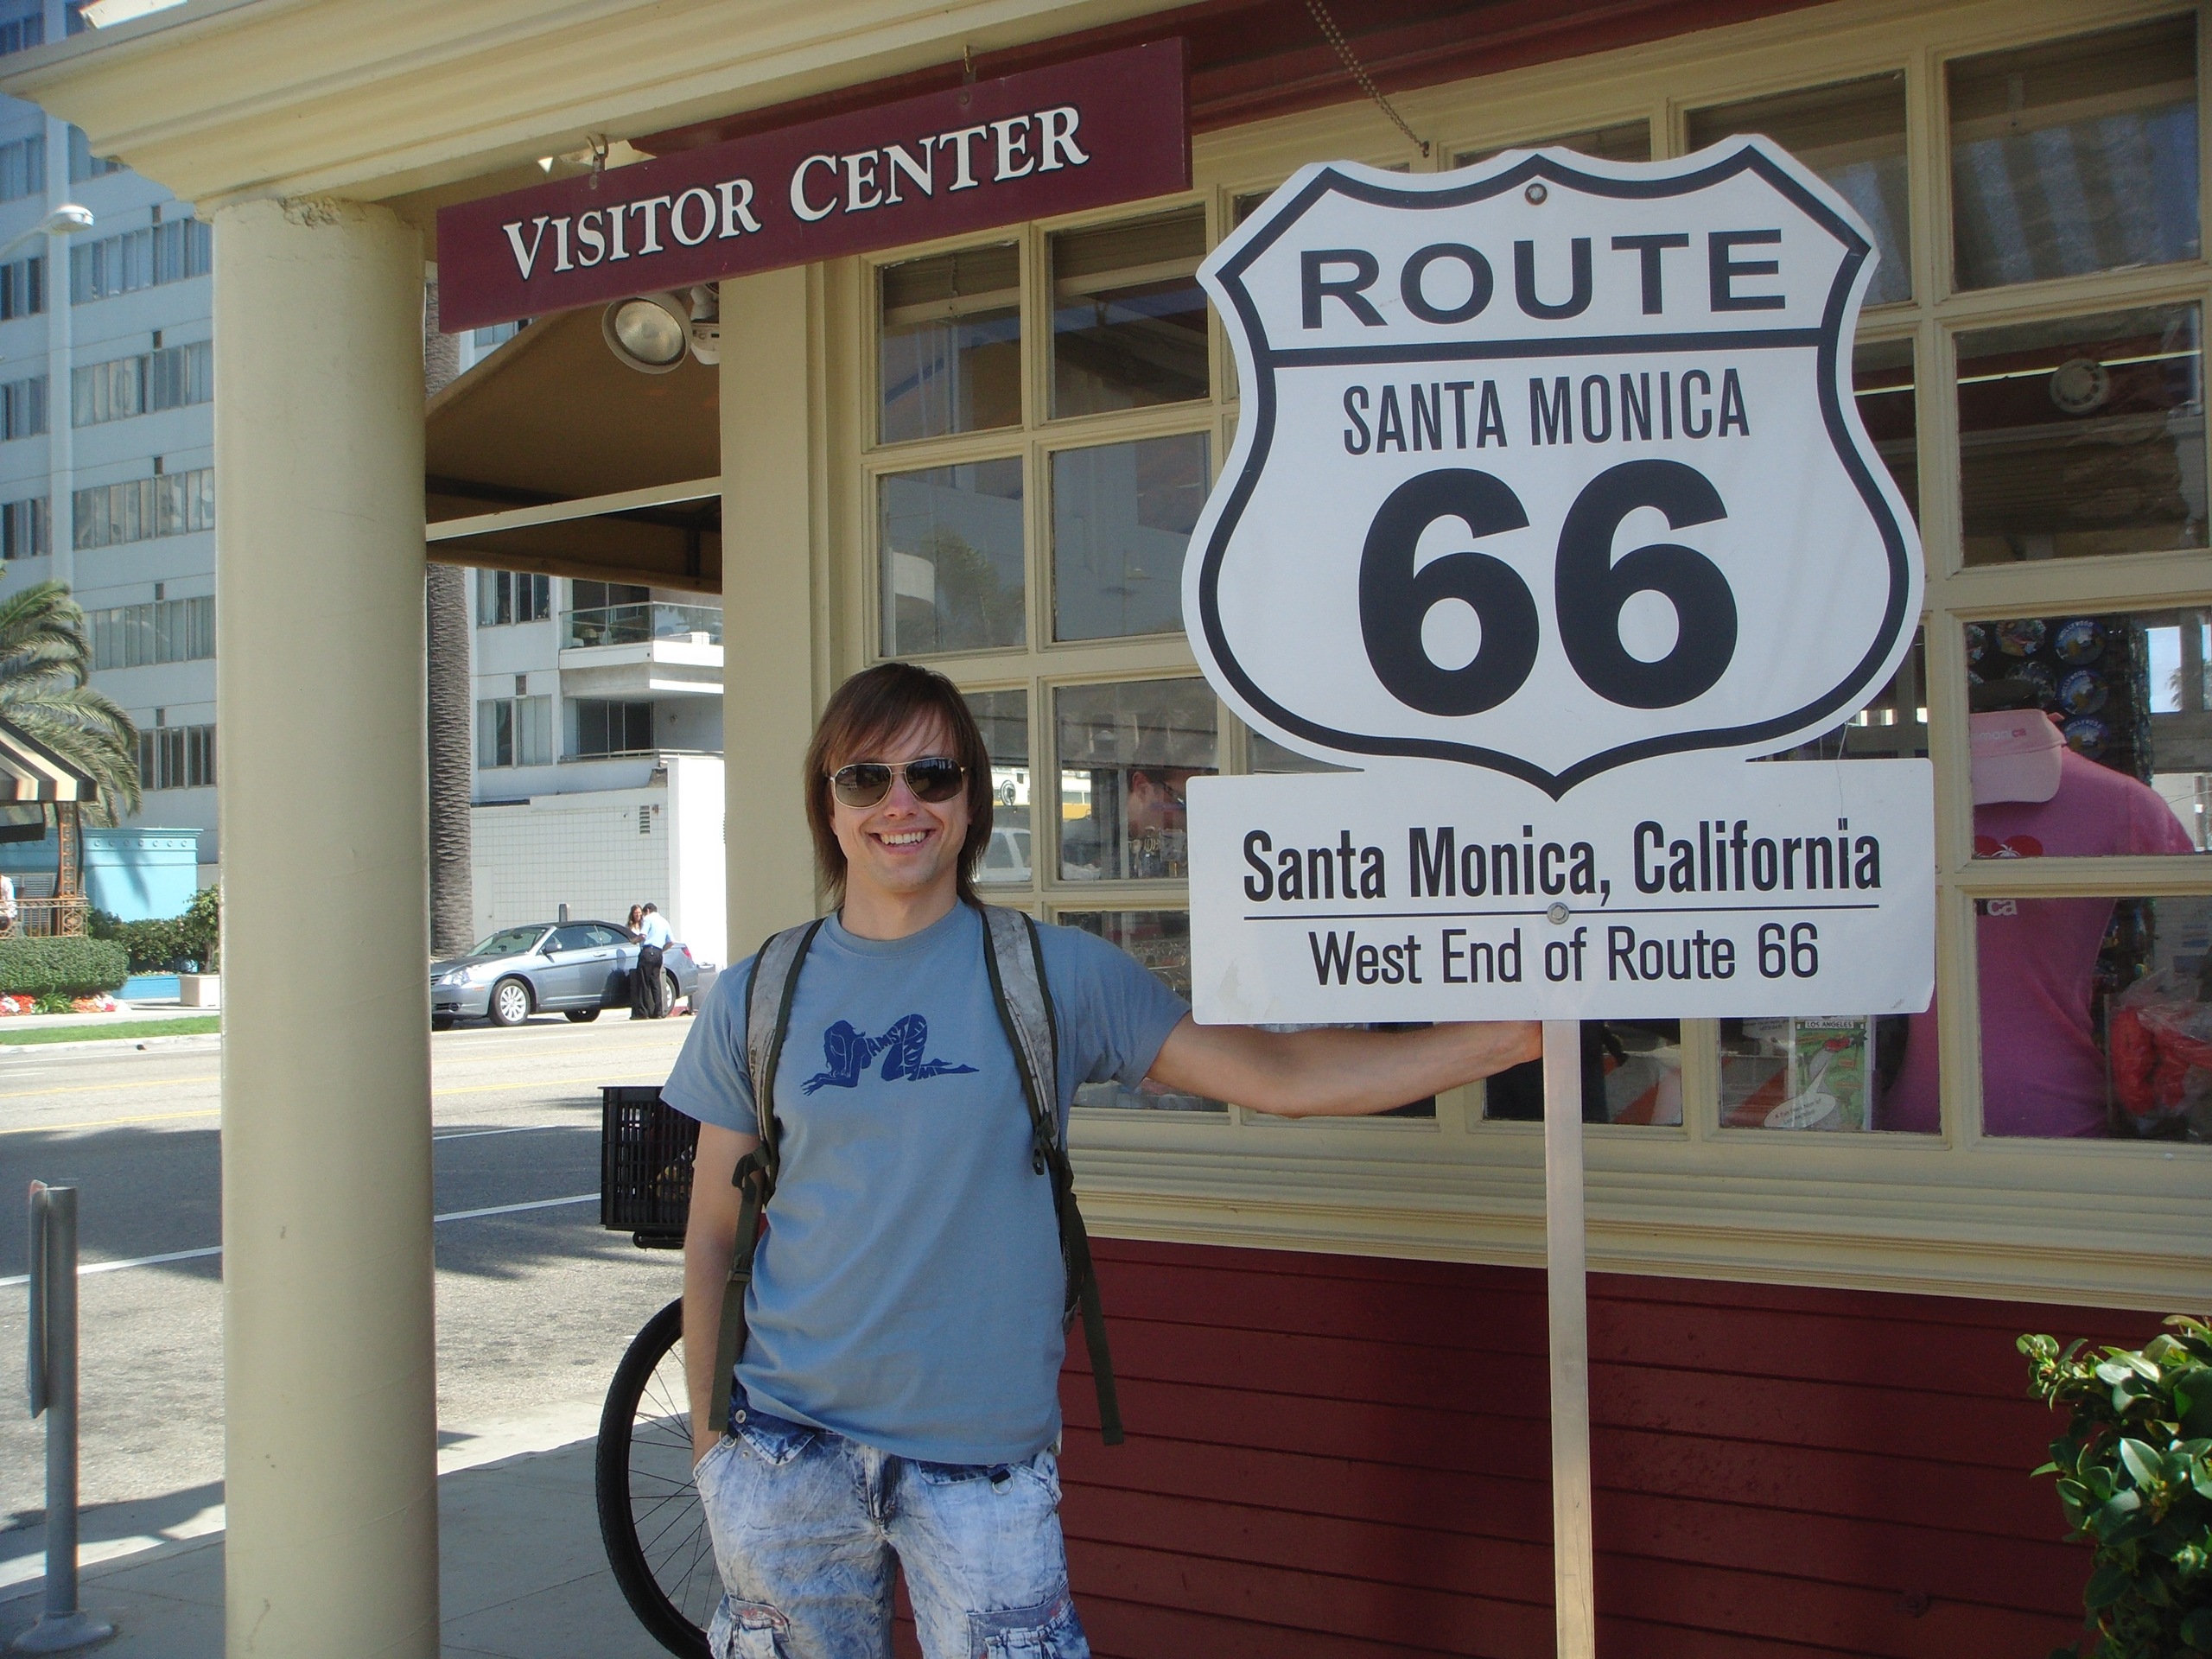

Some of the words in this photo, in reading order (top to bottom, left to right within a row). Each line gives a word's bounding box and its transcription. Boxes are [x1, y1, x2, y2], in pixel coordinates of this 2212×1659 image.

[503, 179, 761, 281] VISITOR
[791, 105, 1090, 221] CENTER
[1300, 228, 1786, 329] ROUTE
[1343, 379, 1508, 455] SANTA
[1529, 367, 1750, 446] MONICA
[1358, 458, 1738, 717] 66
[1243, 830, 1387, 902] Santa
[1408, 824, 1611, 907] Monica,
[1633, 817, 1882, 894] California
[1307, 931, 1423, 986] West
[1442, 927, 1522, 983] End
[1544, 926, 1587, 982] of
[1607, 925, 1736, 981] Route
[1758, 922, 1819, 979] 66
